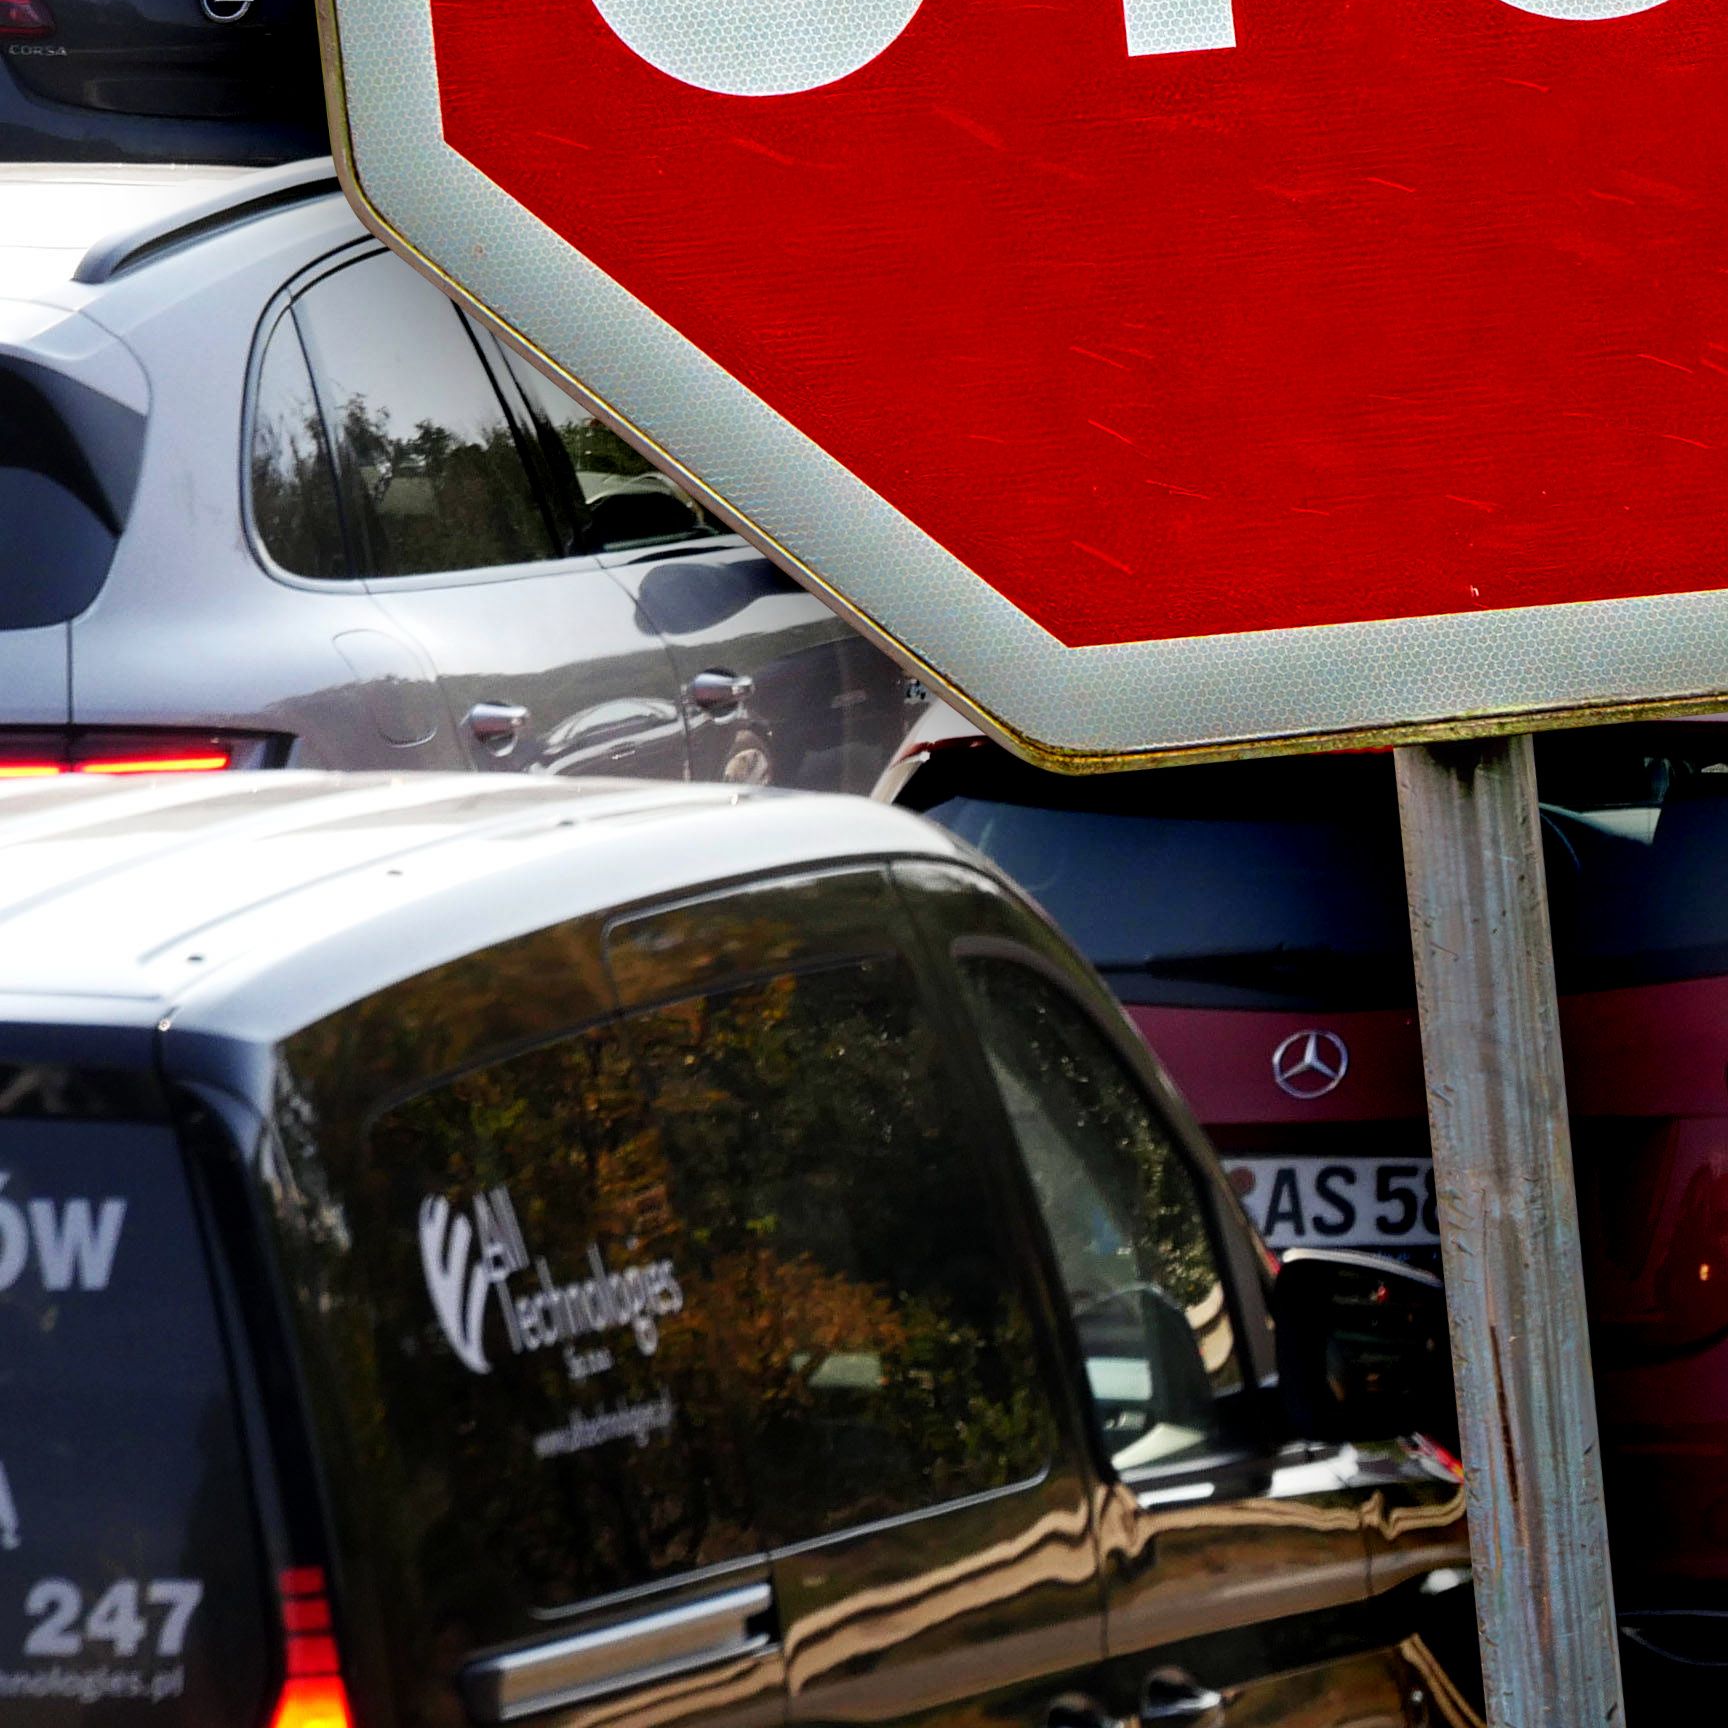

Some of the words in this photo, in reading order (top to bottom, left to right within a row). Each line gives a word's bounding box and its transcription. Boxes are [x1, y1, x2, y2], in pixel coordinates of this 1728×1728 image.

[8, 45, 68, 57] CORSA
[1264, 1166, 1357, 1236] AS
[490, 1241, 684, 1356] Technologies
[24, 1577, 205, 1657] 247
